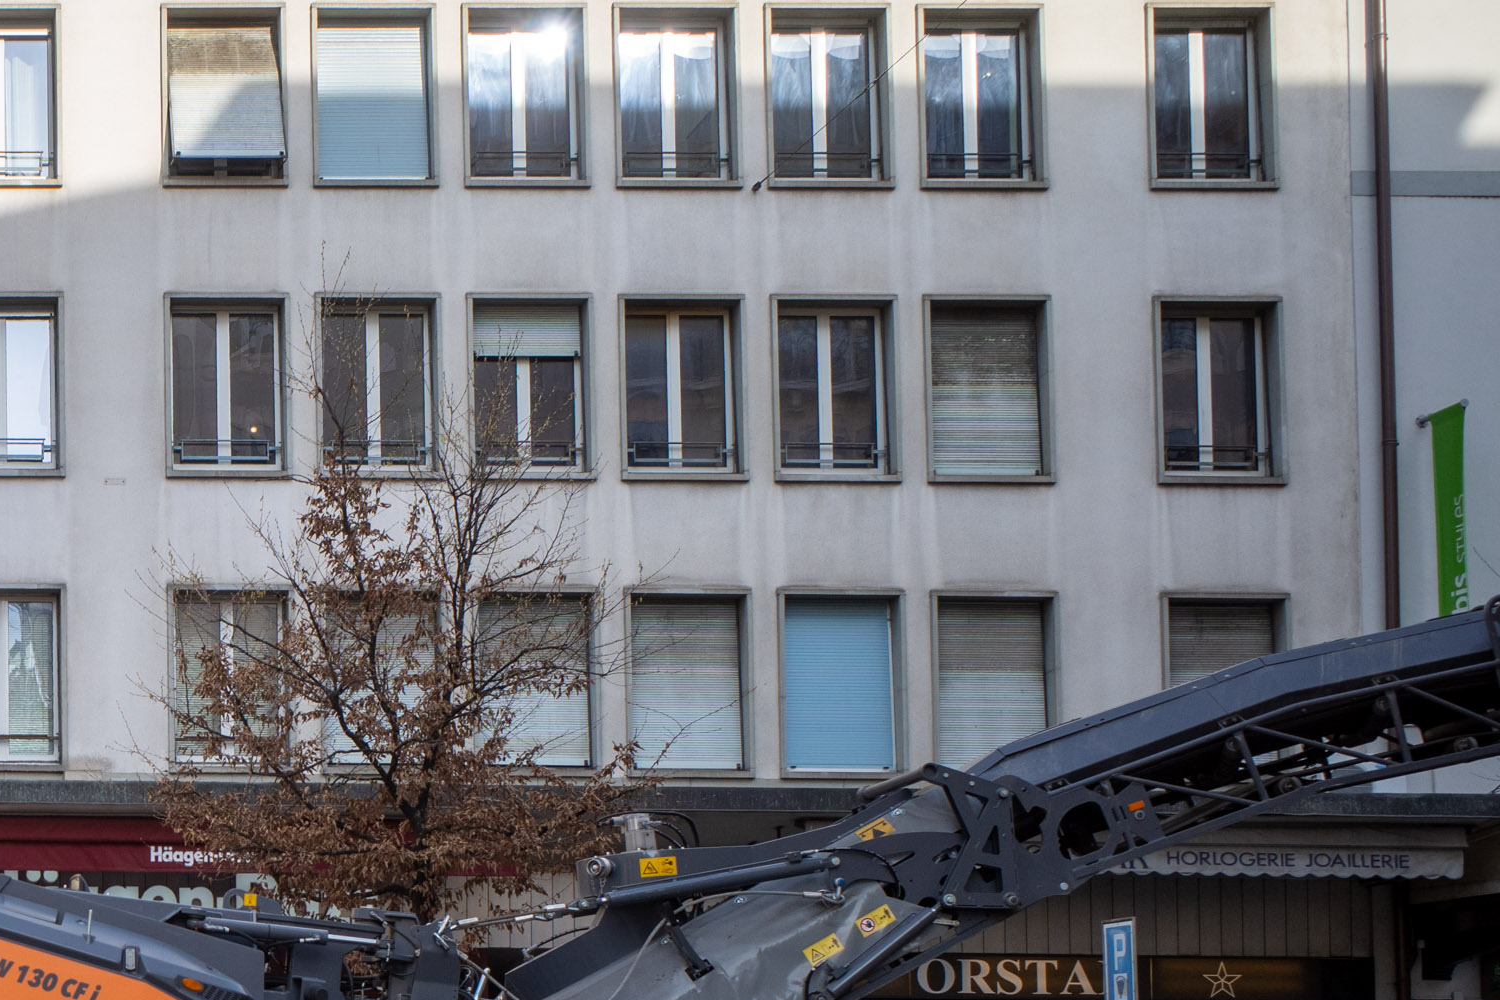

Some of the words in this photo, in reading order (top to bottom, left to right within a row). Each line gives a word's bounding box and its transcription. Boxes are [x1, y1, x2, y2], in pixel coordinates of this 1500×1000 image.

[1167, 851, 1296, 867] HORLOGERIE
[1306, 853, 1410, 869] JOAILLERIE
[1113, 933, 1126, 970] P
[17, 965, 59, 993] 130
[916, 957, 1105, 996] ORSTA
